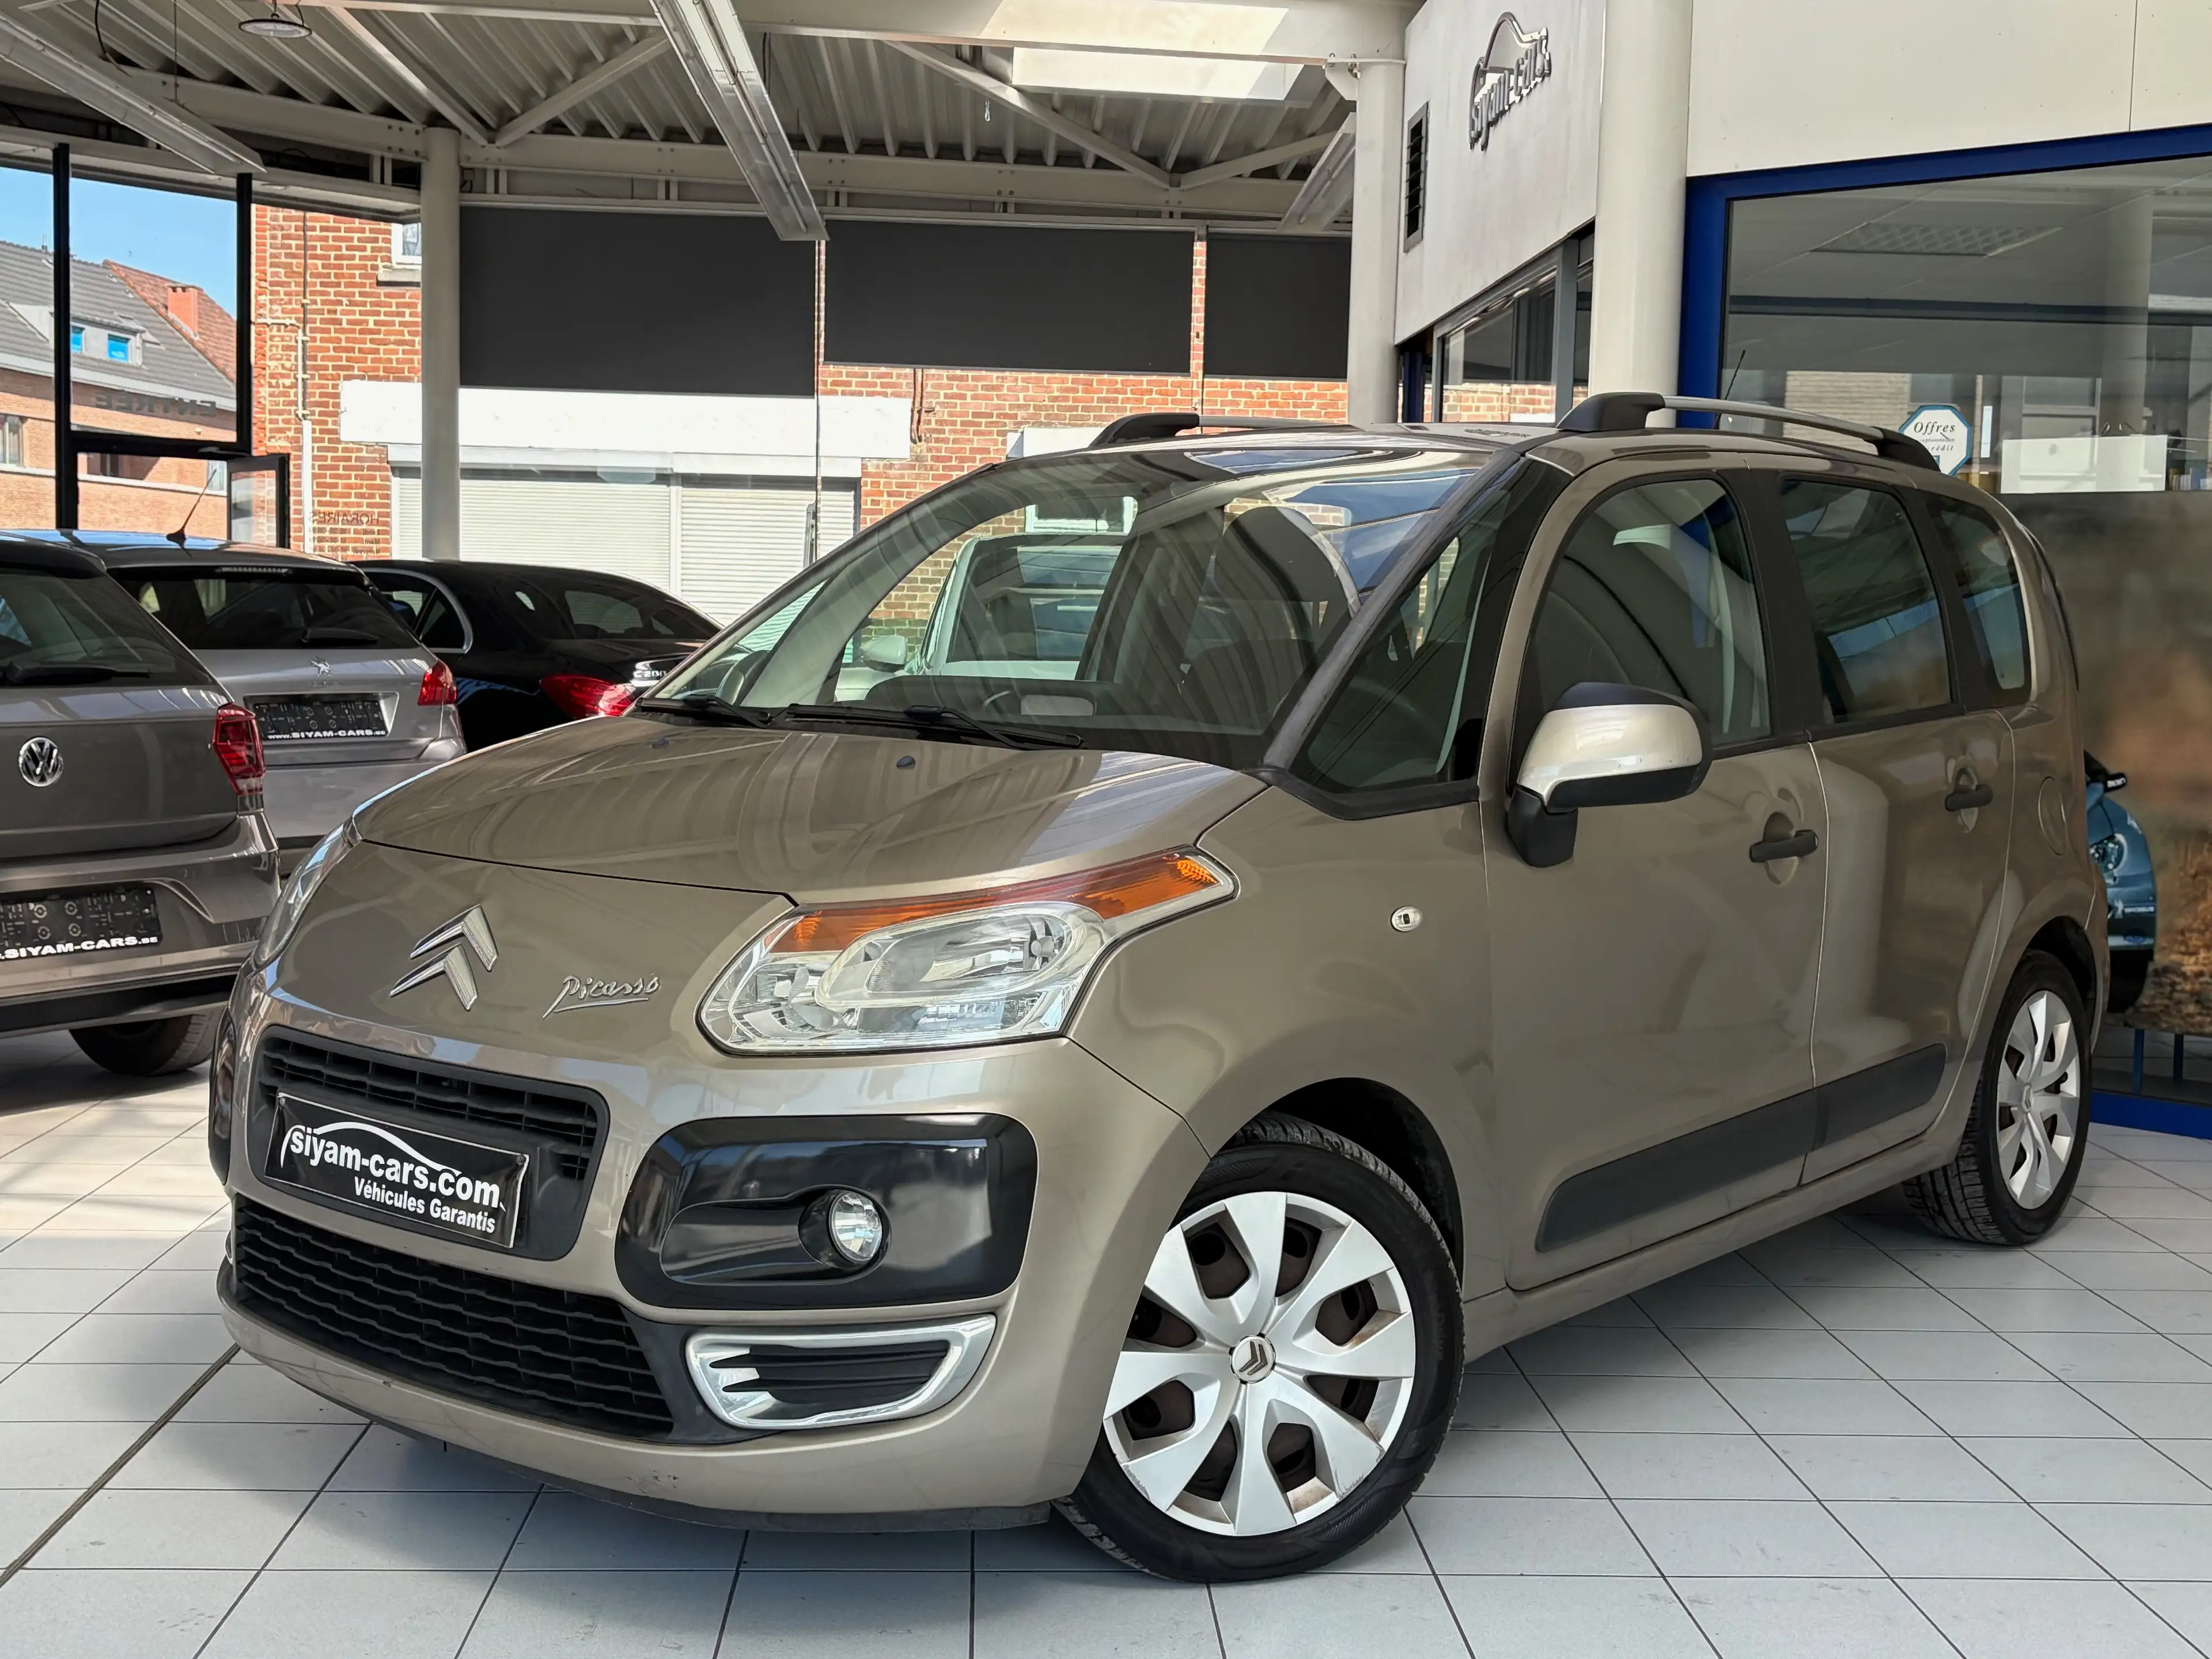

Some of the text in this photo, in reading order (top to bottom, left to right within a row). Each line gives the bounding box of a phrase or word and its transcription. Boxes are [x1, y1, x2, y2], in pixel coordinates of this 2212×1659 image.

[1914, 422, 1956, 435] Offres
[542, 975, 661, 1019] Picasso
[290, 1127, 501, 1209] siyam-cars.com
[354, 1176, 495, 1234] Véhicules Garantis
